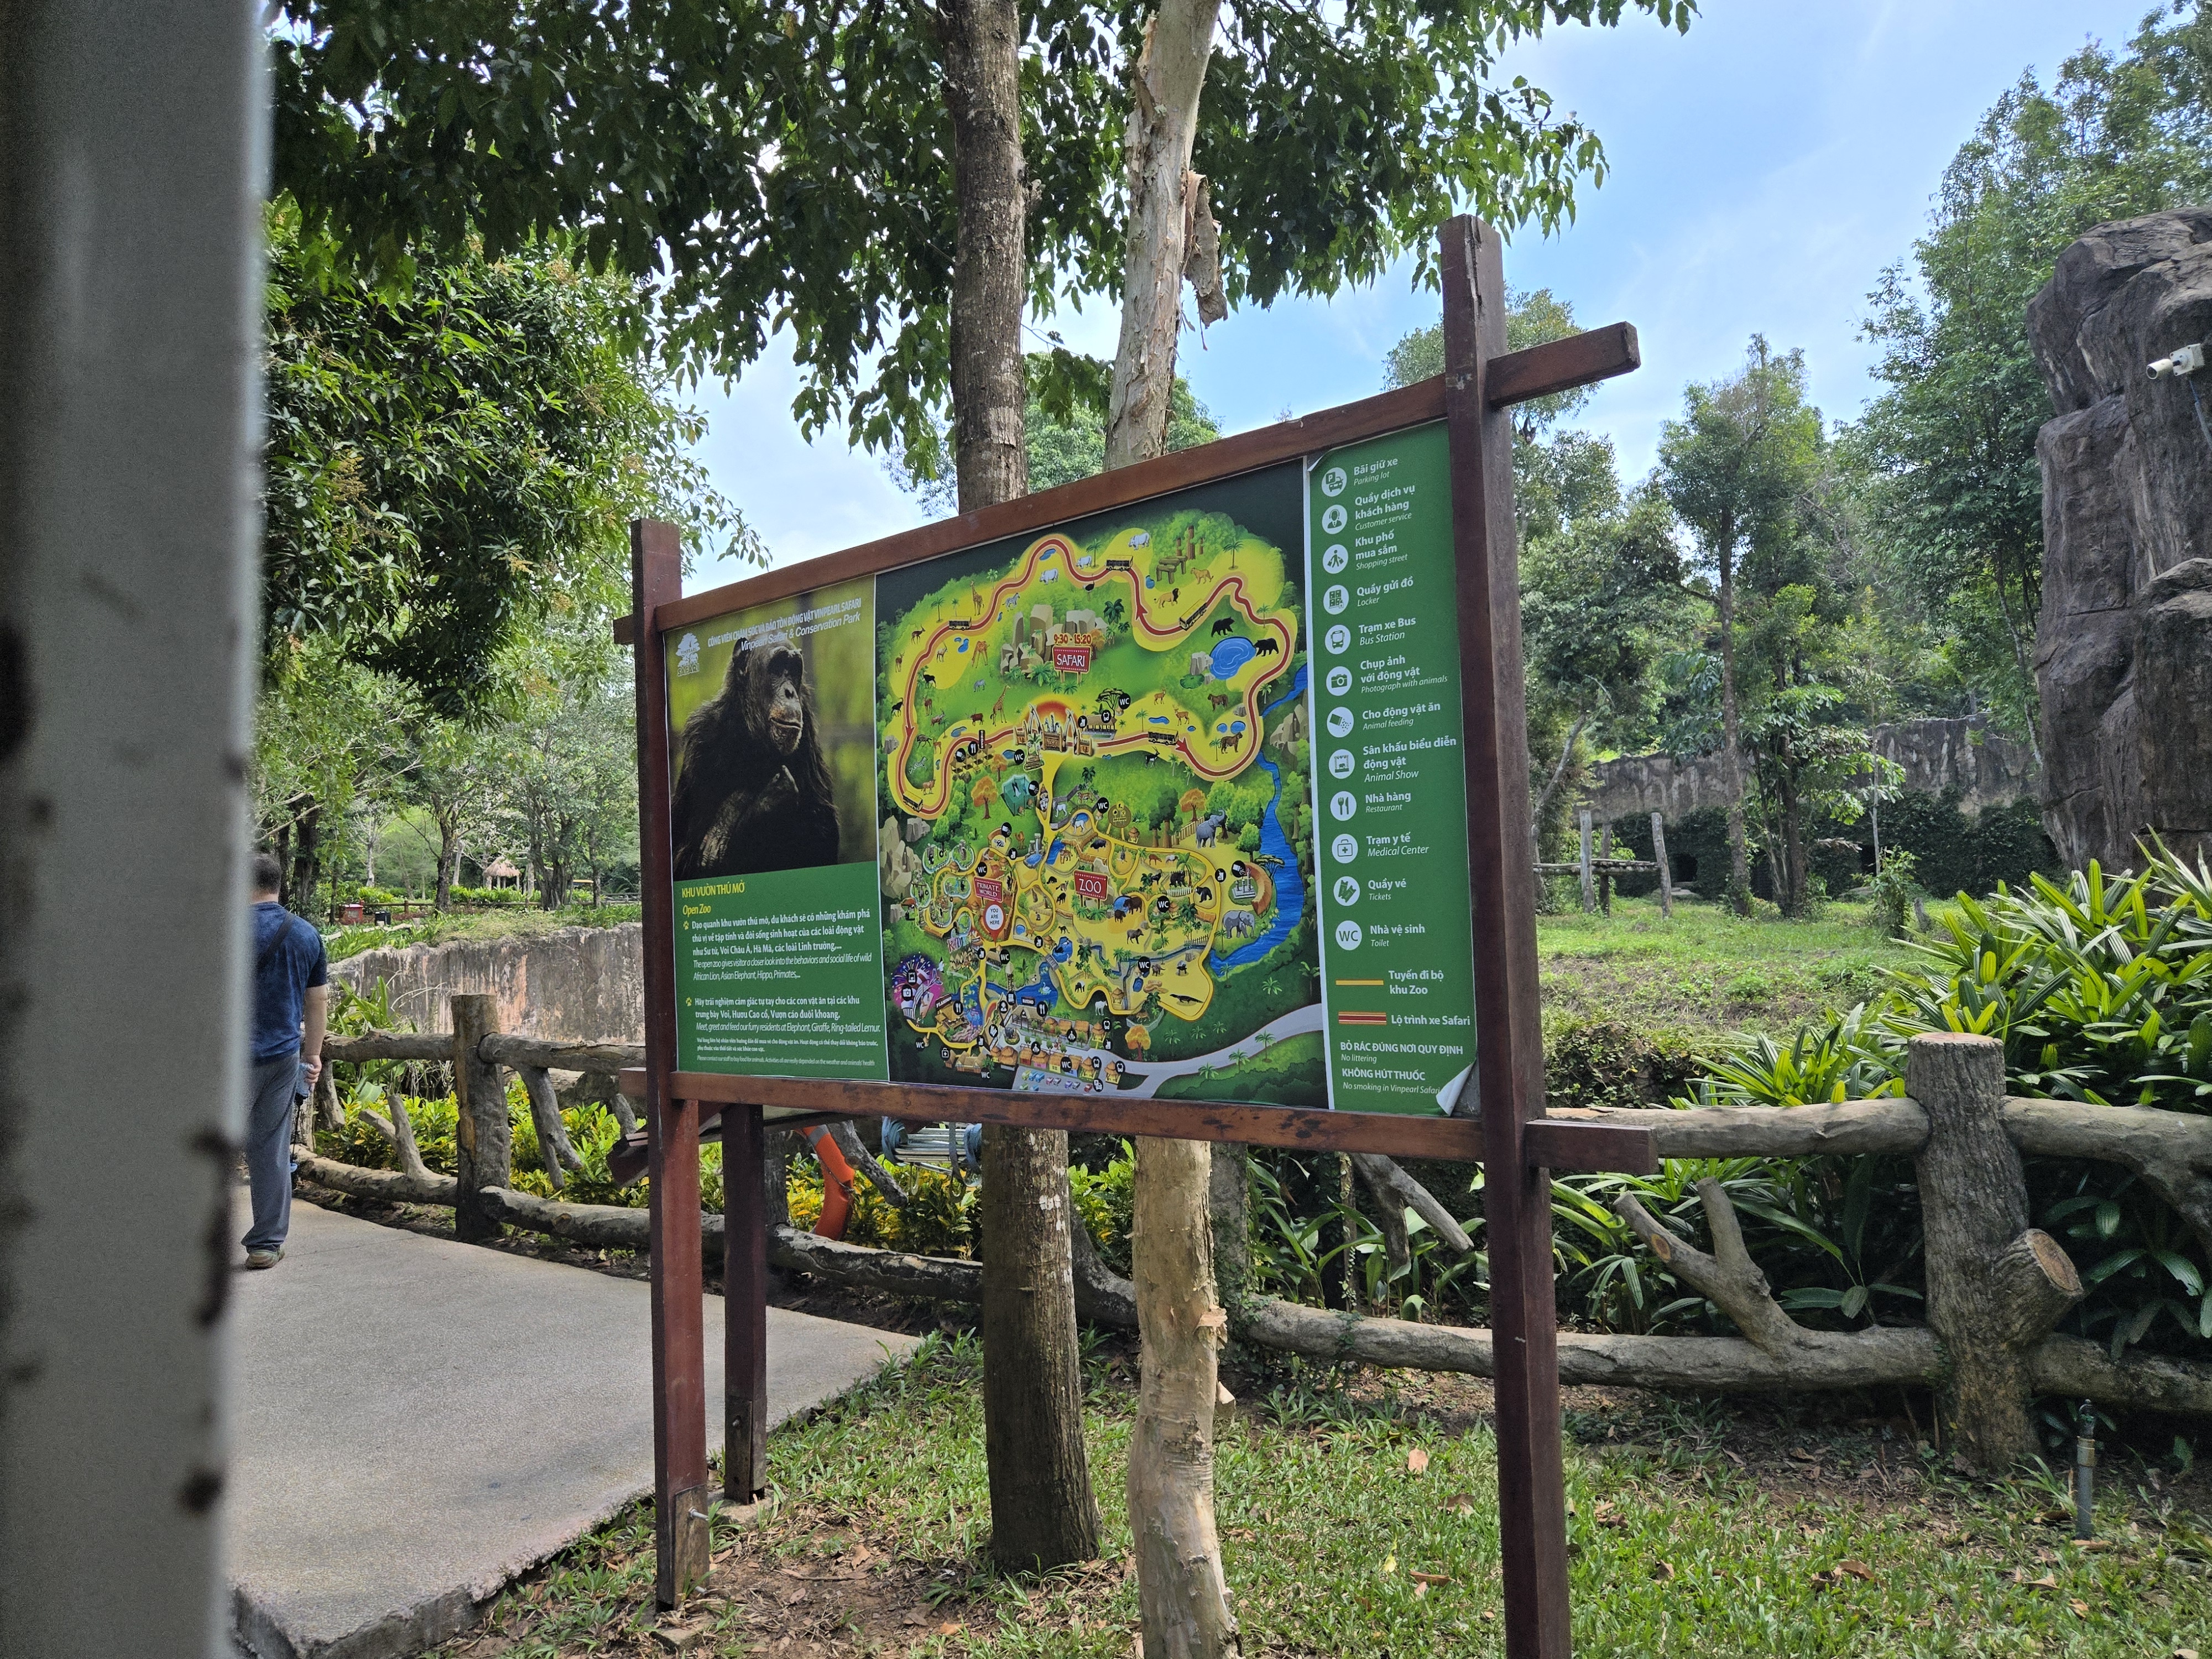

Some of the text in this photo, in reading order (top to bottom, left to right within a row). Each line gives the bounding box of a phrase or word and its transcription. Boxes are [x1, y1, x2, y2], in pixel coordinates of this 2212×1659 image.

[1354, 458, 1398, 476] Bãi giữ xe
[1354, 473, 1379, 486] Parking
[1355, 485, 1415, 506] Quầy dịch vụ
[1355, 500, 1409, 520] khách hàng
[1355, 513, 1412, 531] Customer service
[1355, 529, 1395, 547] Khu phố
[1356, 544, 1397, 560] mua sắm
[1356, 553, 1408, 570] Shopping street
[1357, 576, 1413, 596] Quầy gửi đồ
[1357, 596, 1380, 607] Locker
[804, 610, 814, 622] VẬT
[814, 604, 841, 619] VINPEARL
[841, 598, 861, 612] SAFARI
[789, 629, 794, 639] &
[795, 618, 841, 637] Conservation
[843, 612, 860, 624] Park
[1359, 617, 1416, 634] Trạm xe Bus
[1054, 634, 1068, 644] 9:30
[1074, 634, 1091, 644] 15:20
[1360, 631, 1405, 645] Bus Station
[1057, 654, 1085, 667] SAFARI
[1360, 654, 1405, 671] Chụp ảnh
[677, 664, 700, 676] SAFARI
[1361, 666, 1420, 684] với động vật
[1361, 675, 1448, 693] Photograph with animals
[1363, 702, 1441, 720] Cho động vật ăn
[1363, 718, 1413, 731] Animal feeding
[1363, 735, 1457, 755] Sân khấu biểu diễn
[1363, 756, 1406, 771] động vật
[1364, 769, 1419, 782] Animal Show
[1365, 791, 1411, 804] Nhà hàng
[1366, 804, 1402, 813] Restaurant
[1366, 832, 1411, 846] Trạm y tế
[1368, 845, 1429, 857] Medical Center
[682, 887, 695, 898] KHU
[716, 881, 731, 894] THÚ
[732, 879, 745, 893] MỞ
[977, 882, 1000, 893] PRIMATE
[1078, 878, 1102, 894] ZOO
[1368, 878, 1406, 890] Quầy vé
[979, 889, 998, 897] WORLD
[683, 904, 711, 917] Open Zoo
[692, 921, 702, 930] Dạo
[703, 919, 719, 930] quanh
[721, 919, 732, 927] khu
[771, 915, 779, 924] du
[780, 914, 798, 924] khách
[807, 913, 814, 921] có
[837, 910, 855, 919] khám
[857, 909, 870, 921] phá
[1339, 931, 1359, 942] WC
[1370, 924, 1425, 936] Nhà vệ sinh
[1388, 969, 1444, 982] Tuyến đi bộ
[1390, 985, 1428, 994] khu Zoo
[1391, 1014, 1470, 1026] Lộ trình xe Safari
[1340, 1040, 1463, 1056] BỎ RÁC ĐÚNG NƠI QUY ĐỊNH
[1352, 1053, 1377, 1064] littering
[1342, 1068, 1426, 1081] KHÔNG HÚT THUỐC
[1353, 1083, 1381, 1093] smoking
[1390, 1084, 1419, 1093] Vinpearl
[1420, 1086, 1441, 1094] Safari
